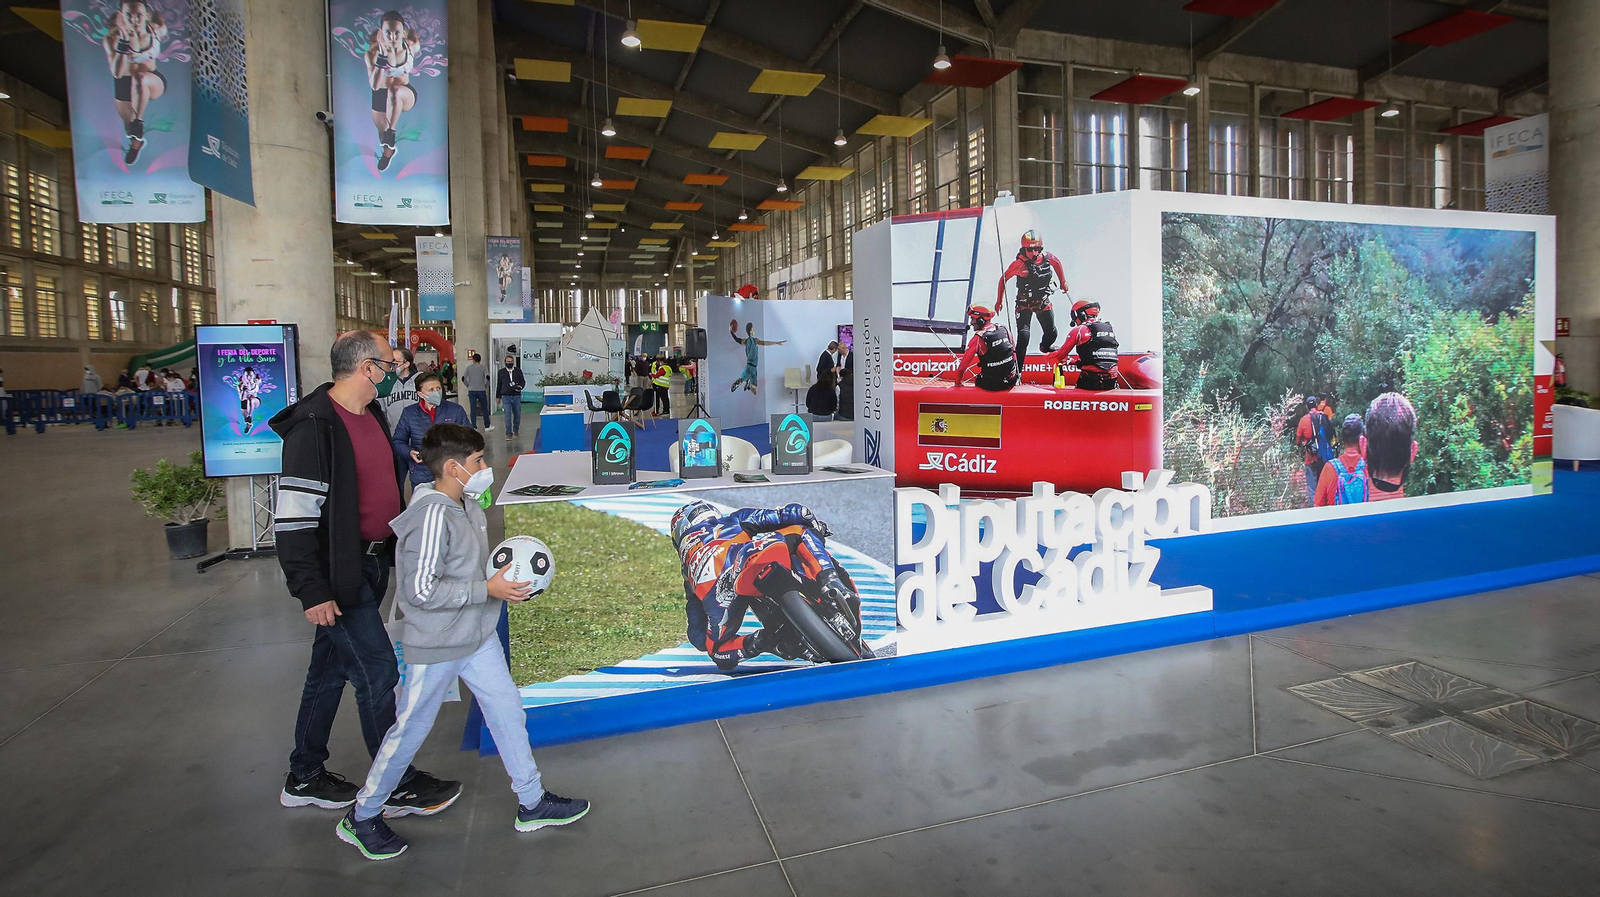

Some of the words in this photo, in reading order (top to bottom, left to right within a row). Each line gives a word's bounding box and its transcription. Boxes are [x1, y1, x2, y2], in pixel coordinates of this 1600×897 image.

[1490, 127, 1544, 149] IFECA
[100, 190, 134, 199] IFECA
[353, 194, 384, 202] IFECA
[419, 242, 449, 250] IFECA
[217, 357, 225, 368] y
[863, 318, 871, 418] Diputación
[872, 335, 882, 388] Cádiz
[873, 397, 882, 420] de
[1043, 400, 1129, 412] ROBERTSON
[944, 452, 997, 474] Cádiz
[893, 469, 1211, 576] Diputación
[895, 556, 978, 632] de
[992, 540, 1161, 618] Cádiz
